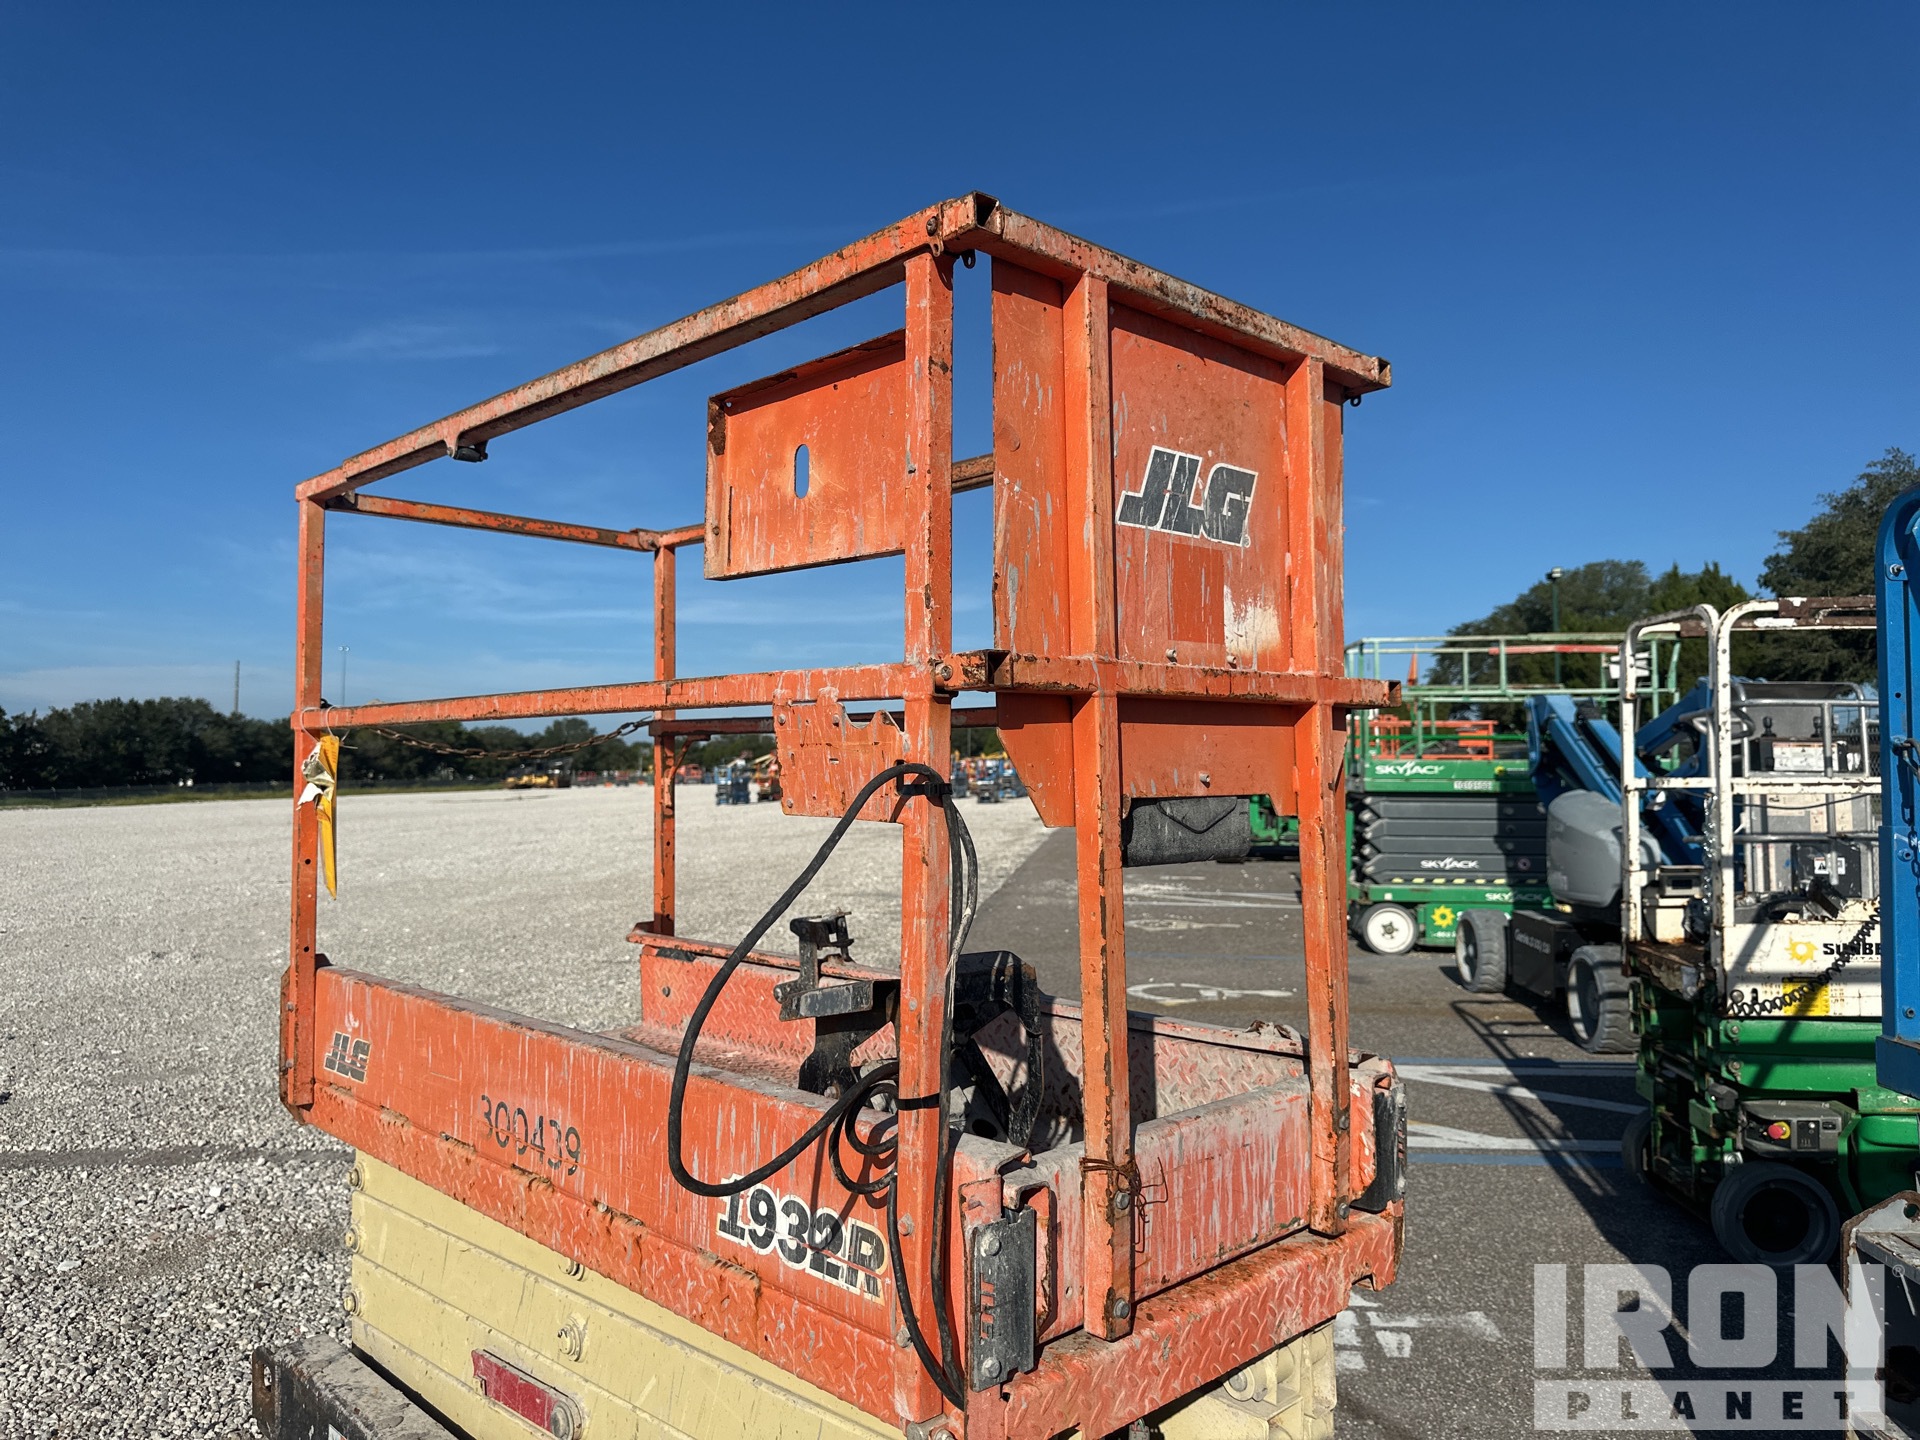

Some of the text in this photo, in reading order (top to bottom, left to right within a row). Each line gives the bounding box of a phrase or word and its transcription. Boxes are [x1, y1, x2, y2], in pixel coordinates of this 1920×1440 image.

[1115, 445, 1258, 548] JLG
[1420, 857, 1480, 870] SKYJACK
[323, 1031, 371, 1084] JLG
[481, 1094, 581, 1176] 300439
[716, 1173, 889, 1307] 1932R
